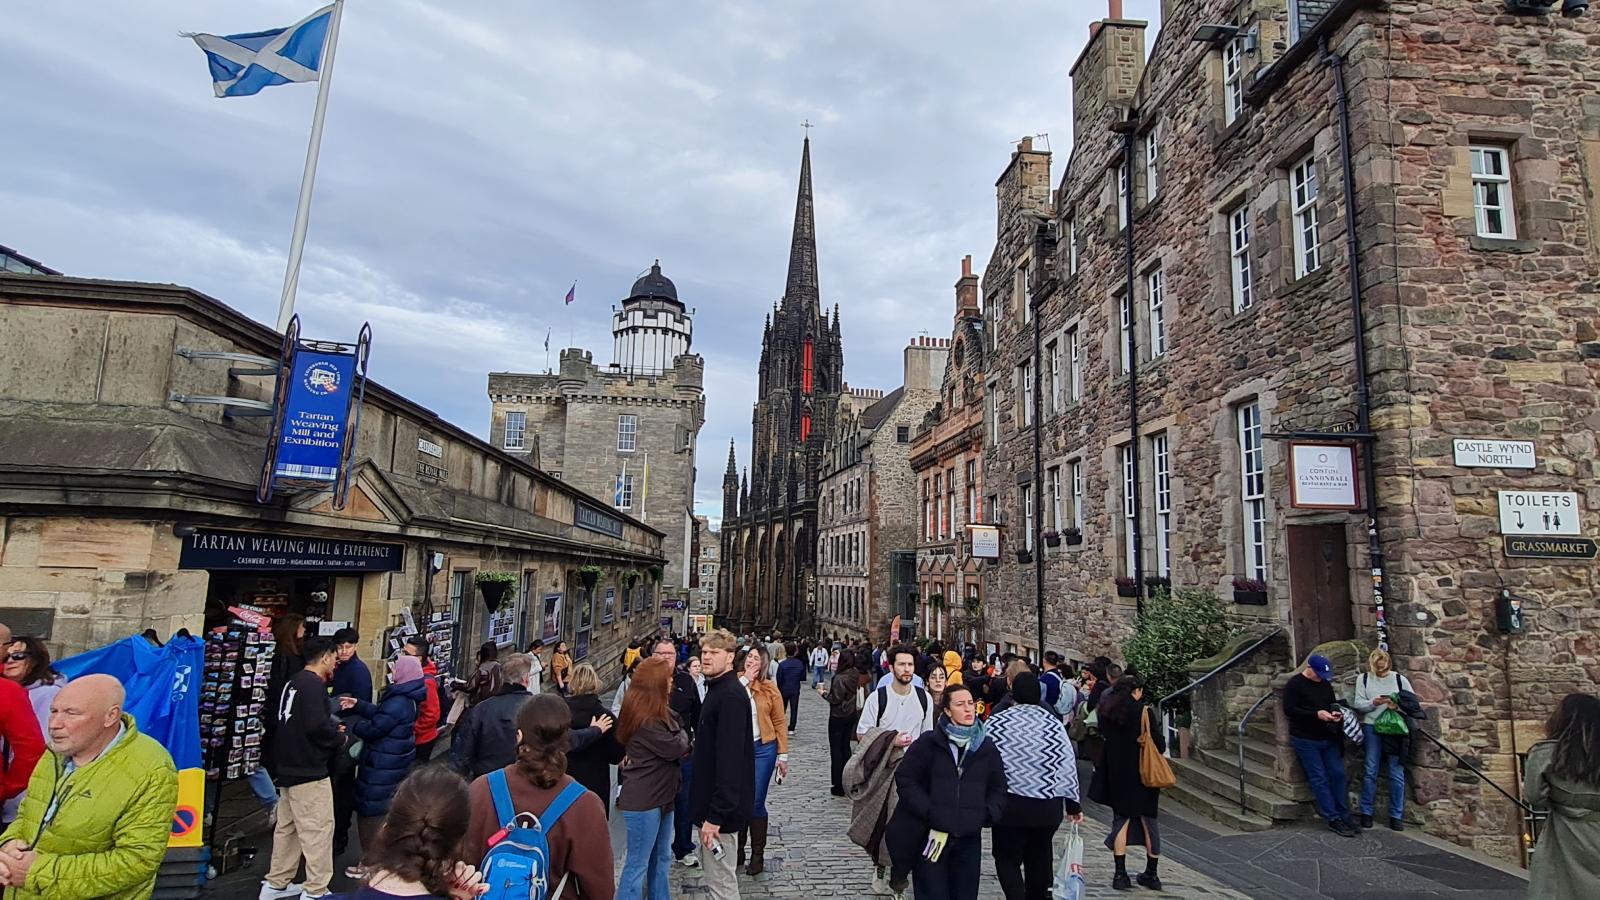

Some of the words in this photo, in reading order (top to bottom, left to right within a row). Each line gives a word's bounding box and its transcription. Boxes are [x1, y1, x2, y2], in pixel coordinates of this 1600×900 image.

[298, 411, 334, 421] Tartan
[290, 419, 339, 431] Weaving
[292, 428, 310, 437] Mill
[313, 431, 335, 439] and
[1456, 442, 1493, 453] CASTLE
[1499, 443, 1532, 454] WYND
[1478, 454, 1513, 465] NORTH
[1505, 494, 1571, 507] TOILETS
[192, 533, 246, 551] TARTAN
[251, 537, 304, 554] WEAVING
[307, 542, 331, 555] MILL
[333, 543, 340, 555] &
[343, 544, 390, 558] EXPERIENCE
[1511, 541, 1589, 554] GRASSMARKET
[237, 556, 266, 565] CASHMERE
[269, 557, 286, 565] TWEED
